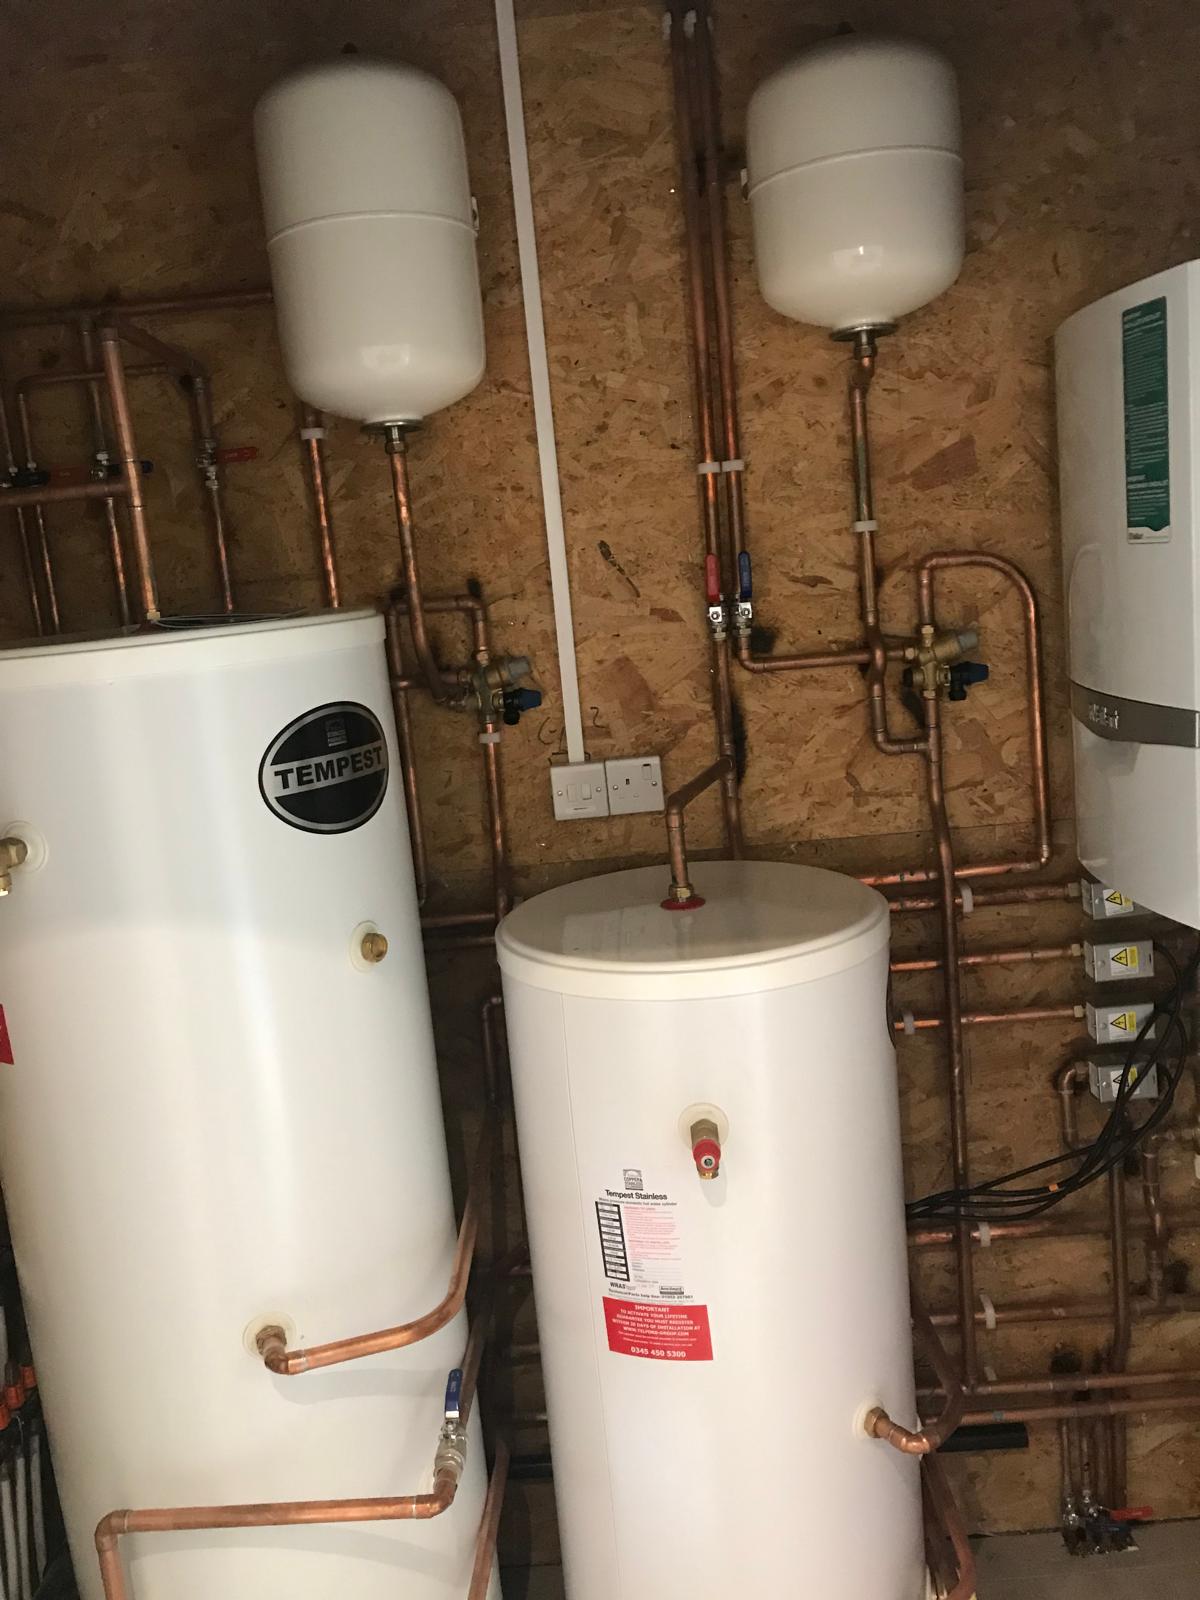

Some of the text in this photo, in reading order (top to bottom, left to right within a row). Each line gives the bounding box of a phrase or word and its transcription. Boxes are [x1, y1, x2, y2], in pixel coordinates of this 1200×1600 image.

[274, 746, 382, 790] TEMPEST
[605, 1189, 668, 1200] Tempest Stainless
[627, 1310, 649, 1318] ACTIVATE
[635, 1304, 670, 1313] IMPORTANT
[630, 1346, 687, 1358] 0345 450 5300
